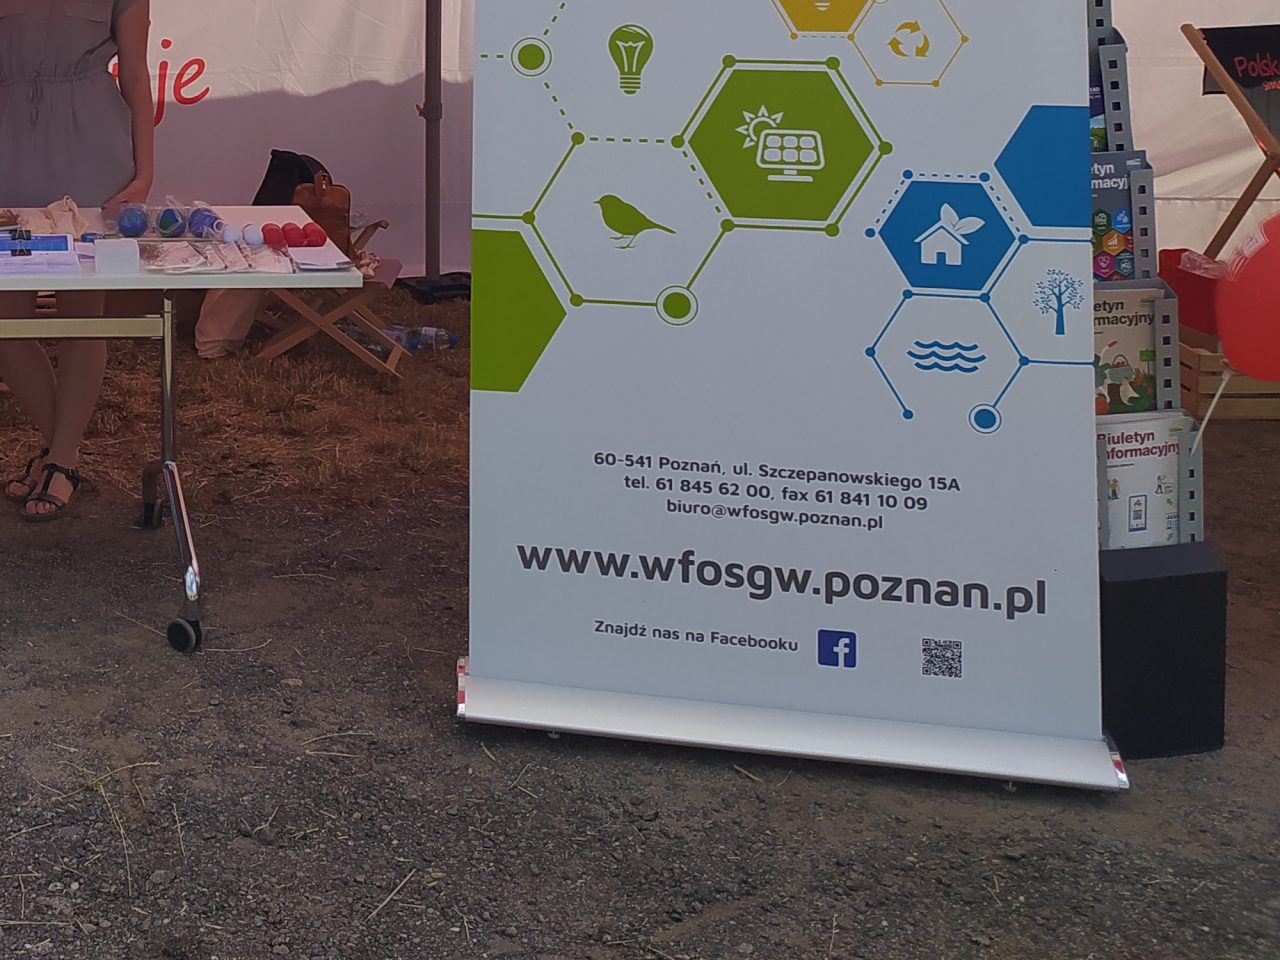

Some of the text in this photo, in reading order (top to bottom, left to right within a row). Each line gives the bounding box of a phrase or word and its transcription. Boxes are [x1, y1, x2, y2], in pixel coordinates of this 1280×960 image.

[1234, 52, 1280, 77] Polsk
[1093, 300, 1124, 313] etyn
[1093, 311, 1155, 327] rmacyjny
[1106, 442, 1179, 460] formacyjn
[593, 452, 961, 491] 60-541 Poznań, ul. Szczepanowskiego 15A
[624, 475, 928, 511] tel. 61 845 62 00, fax 61 841 10 09
[666, 499, 883, 531] biuro@wfosgw.poznan.pl
[516, 544, 1046, 620] www.wfosgw.poznan.pl
[652, 627, 680, 641] nas
[685, 630, 705, 643] na
[710, 631, 799, 652] Facebooku
